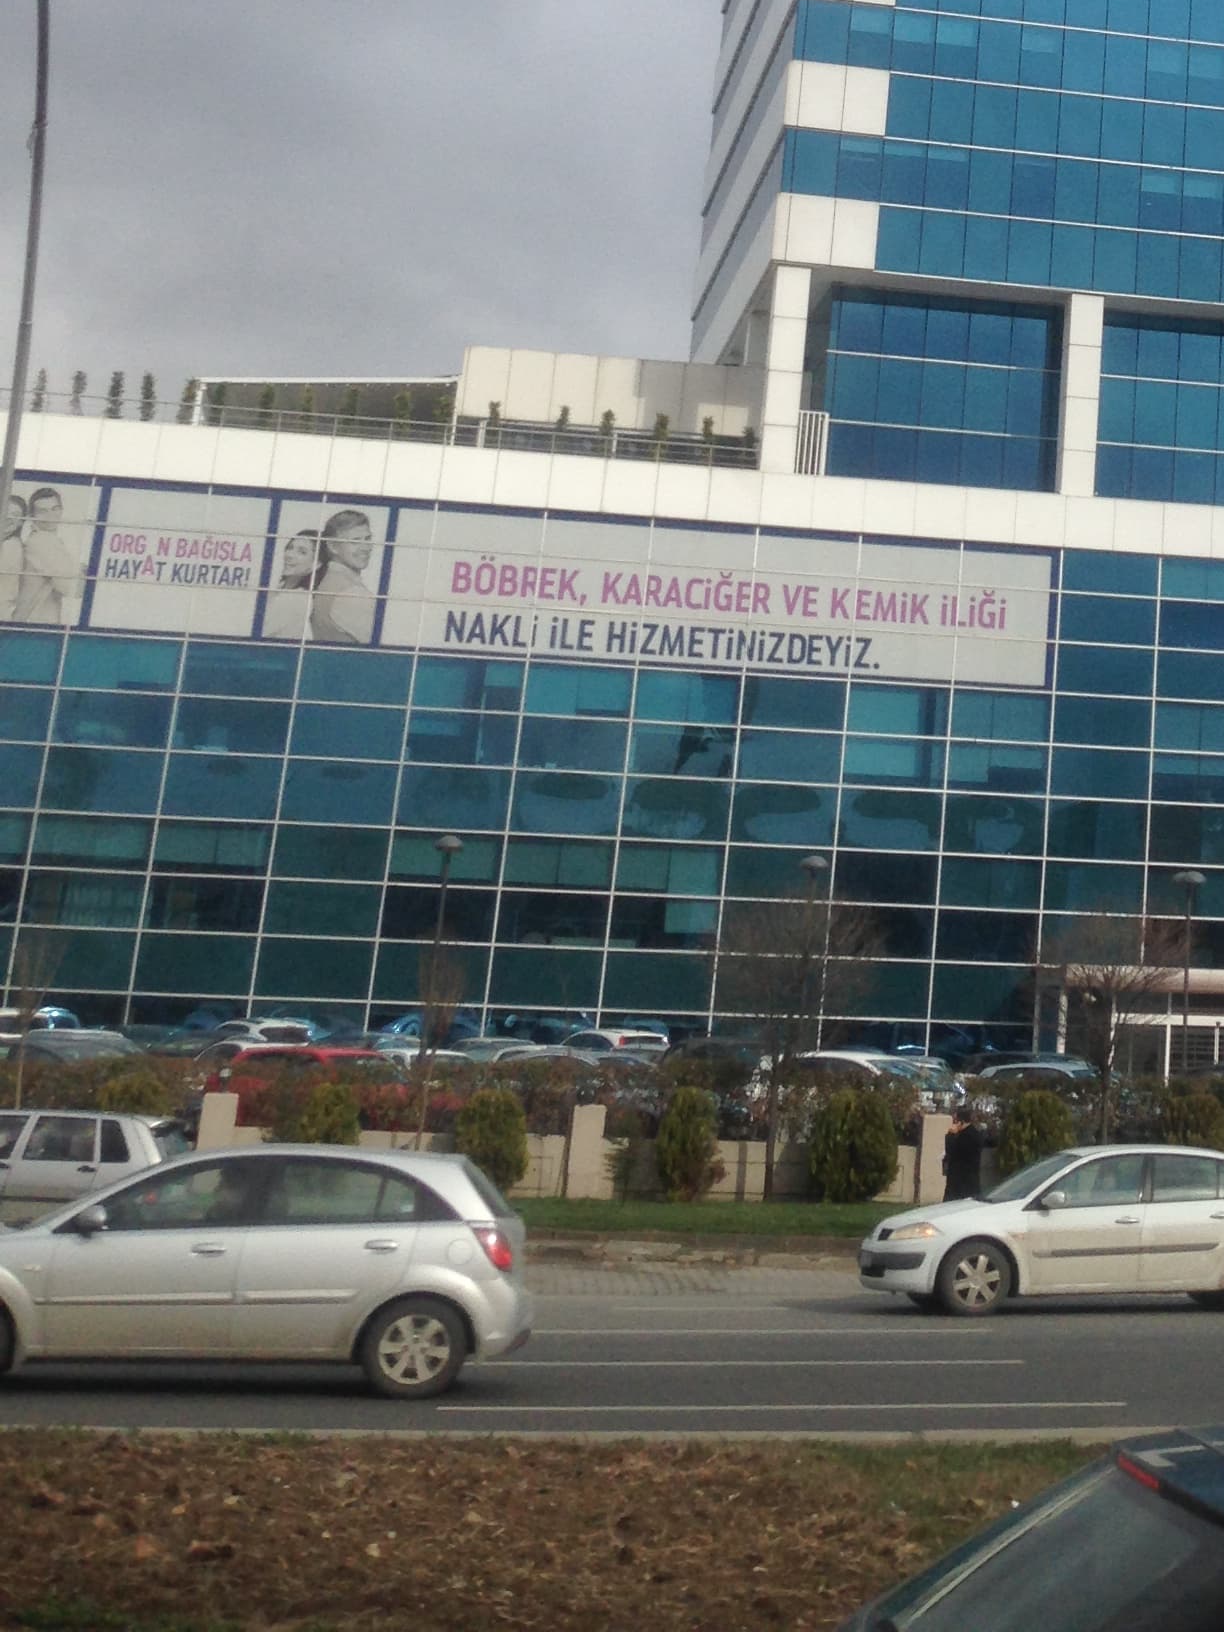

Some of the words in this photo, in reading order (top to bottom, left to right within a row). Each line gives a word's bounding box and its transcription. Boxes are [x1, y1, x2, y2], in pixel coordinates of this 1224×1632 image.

[105, 555, 167, 581] HAYAT
[171, 563, 250, 587] KURTAR!
[450, 555, 588, 607] BÖBREK,
[600, 571, 771, 615] KARACİĞER
[783, 584, 820, 618] VE
[830, 588, 930, 626] KEMİK
[443, 610, 539, 649] NAKLİ
[550, 616, 596, 652] İLE
